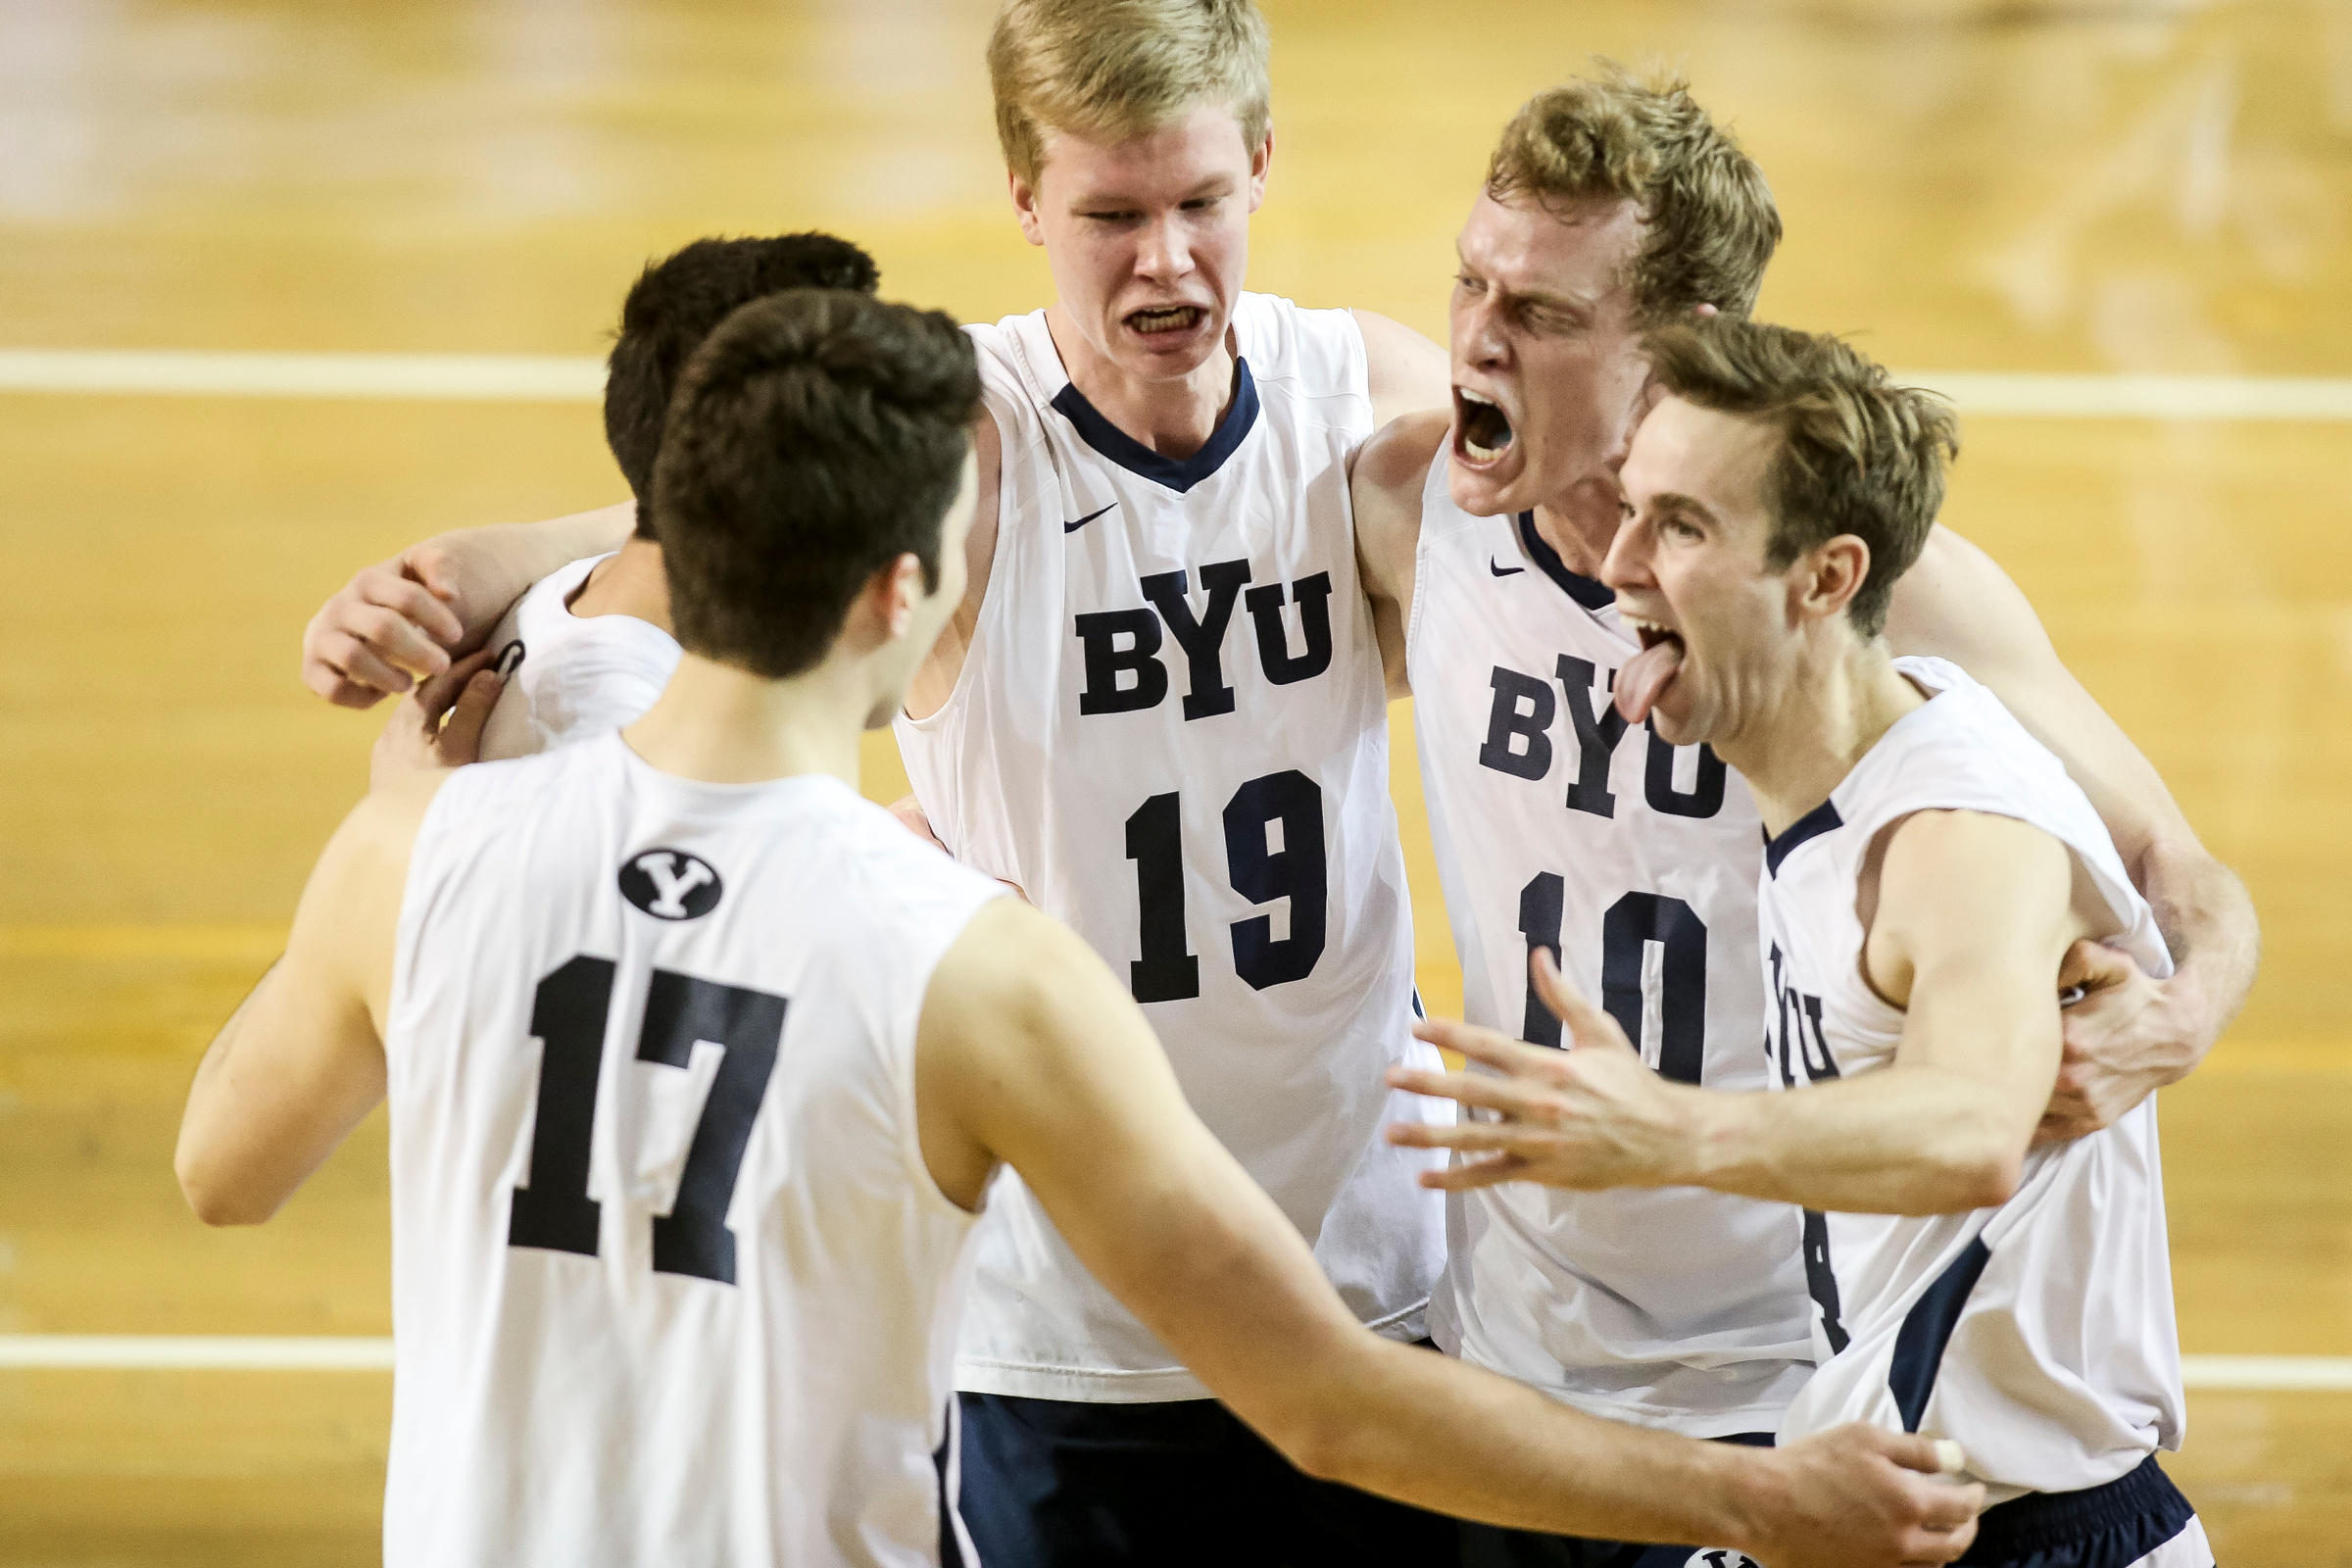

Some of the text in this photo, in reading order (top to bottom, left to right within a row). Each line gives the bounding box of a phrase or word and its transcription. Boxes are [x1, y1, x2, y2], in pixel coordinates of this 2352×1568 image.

[1075, 558, 1333, 721] BYU
[635, 851, 714, 918] Y
[1125, 769, 1327, 1004] 19
[1515, 870, 1707, 1087] 10
[508, 954, 790, 1286] 17
